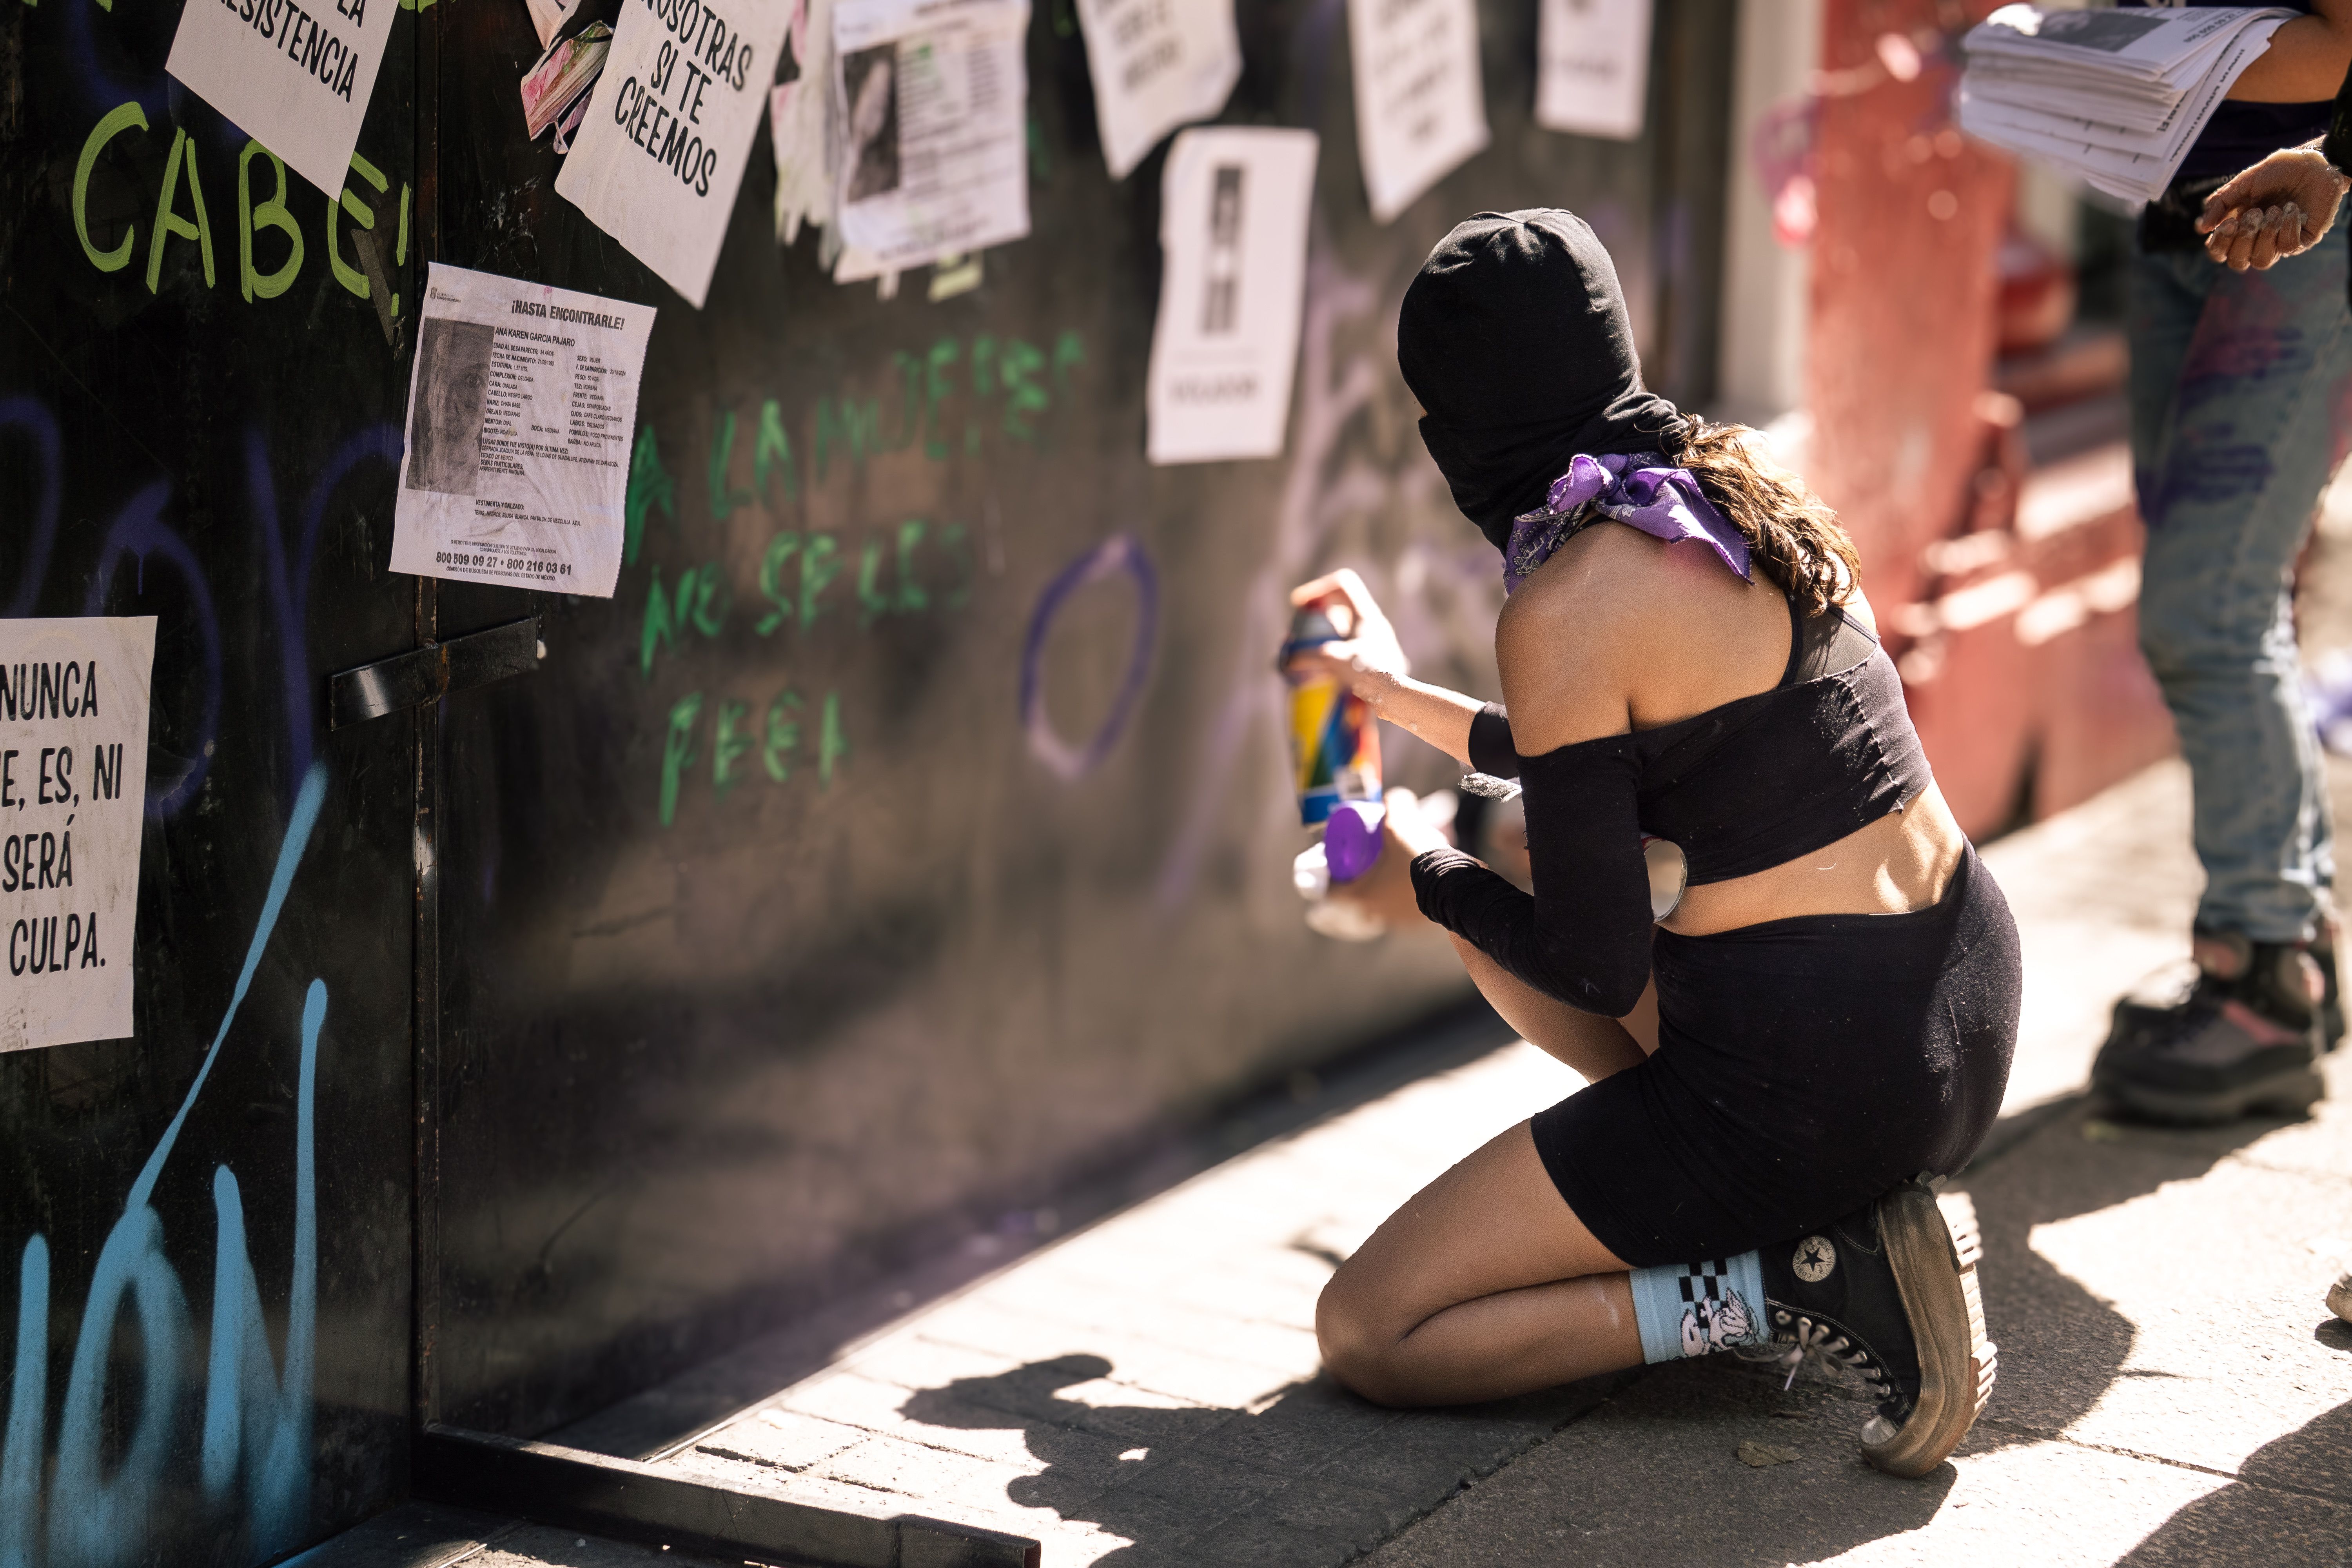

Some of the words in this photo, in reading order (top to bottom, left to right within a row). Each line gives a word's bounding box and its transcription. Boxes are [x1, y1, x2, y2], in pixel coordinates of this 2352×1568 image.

[651, 40, 679, 96] SI
[679, 60, 712, 125] TE
[615, 76, 717, 197] CREEMOS
[511, 299, 546, 318] ¡HASTA
[550, 305, 625, 330] ENCONTRARLE!
[495, 327, 507, 336] ANA
[508, 328, 529, 339] KAREN
[530, 332, 551, 343] GARCIA
[552, 336, 575, 347] PAJARO
[510, 345, 538, 354] DESAPARECER:
[511, 354, 536, 364] NACIMIENTO:
[491, 361, 512, 369] ESTATURA:
[579, 364, 607, 374] DESAPARICIÓN:
[488, 389, 507, 397] CABELLO:
[485, 407, 502, 416] OREJAS:
[586, 403, 611, 411] SEMIPOBLADAS
[600, 433, 623, 441] PROMINENTES
[517, 442, 535, 451] VISTO(A)
[544, 444, 559, 453] ÚLTIMA
[479, 464, 508, 474] APARENTEMENTE
[475, 499, 501, 508] VESTIMENTA
[436, 551, 452, 564] 800
[453, 553, 469, 565] 509
[472, 555, 484, 566] 09
[486, 556, 497, 568] 27
[506, 558, 524, 570] 800
[526, 560, 544, 572] 216
[546, 562, 557, 573] 03
[559, 563, 571, 575] 61
[0, 661, 98, 722] NUNCA
[38, 746, 79, 808] ES,
[93, 743, 123, 801] NI
[2, 814, 75, 893] SERÁ
[9, 912, 106, 976] CULPA.
